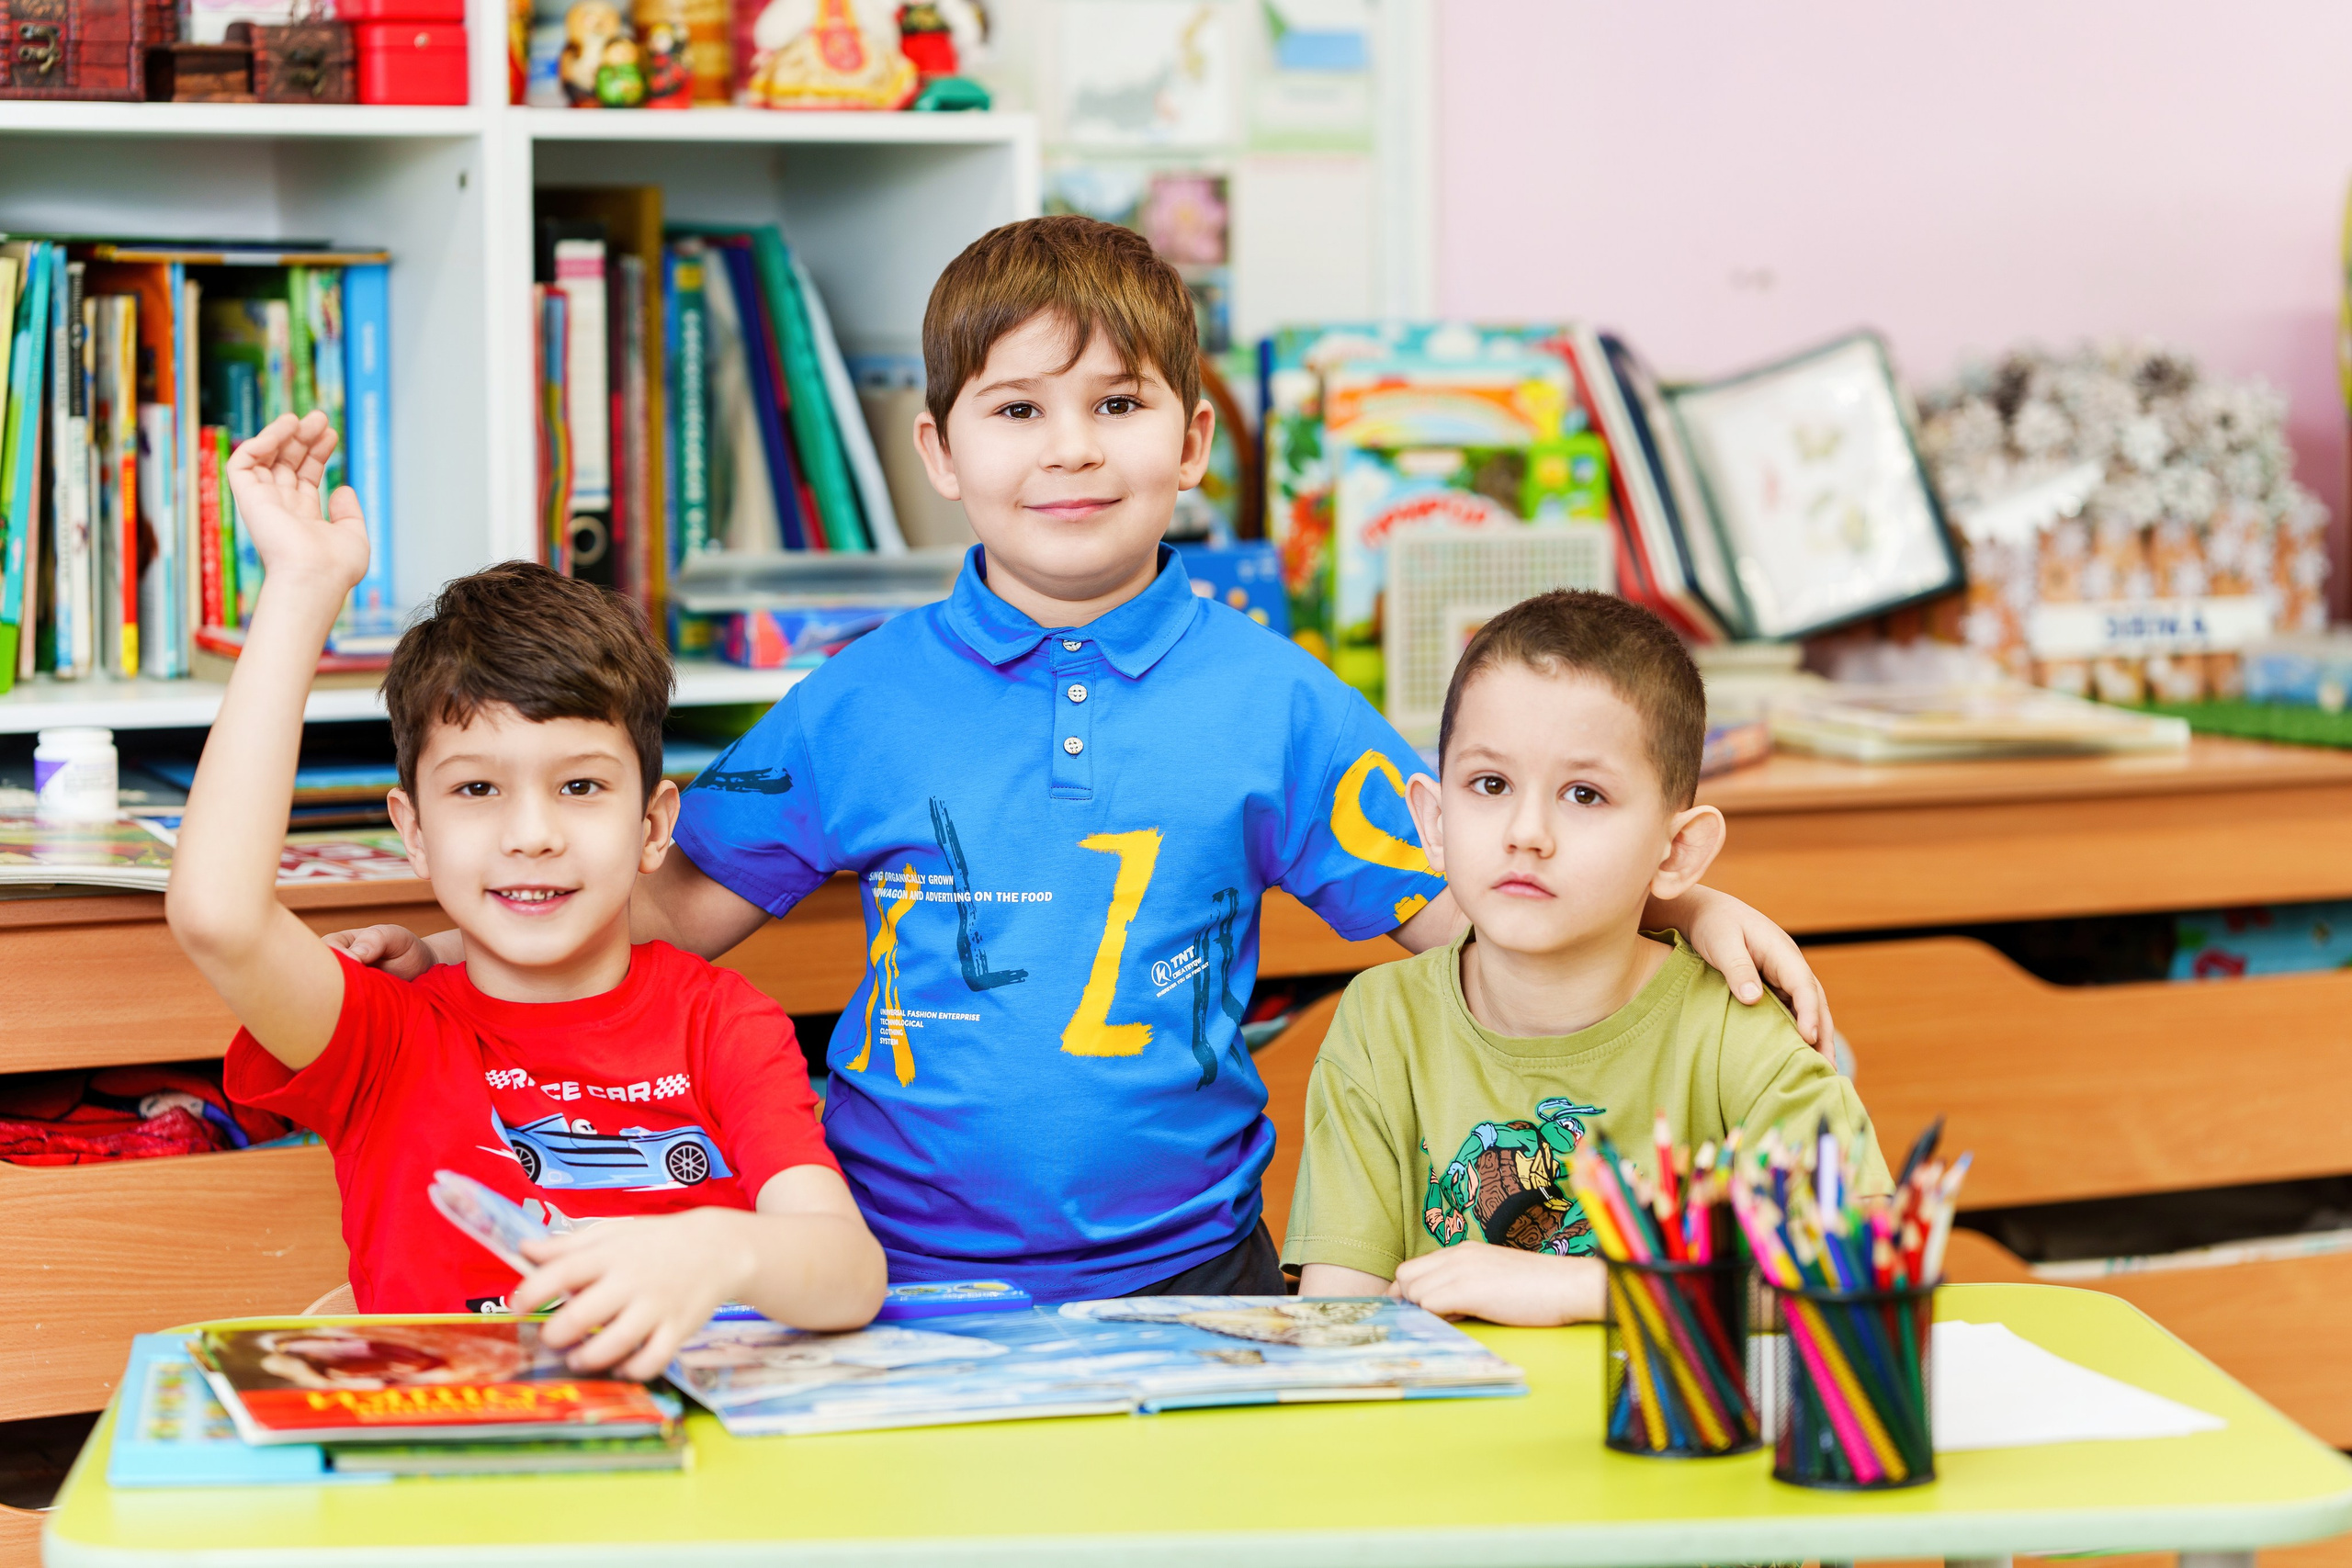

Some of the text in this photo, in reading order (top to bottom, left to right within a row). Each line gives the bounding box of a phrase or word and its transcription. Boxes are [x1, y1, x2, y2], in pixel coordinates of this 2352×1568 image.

[885, 872, 926, 885] ORGANICALLY
[928, 874, 954, 886] GROWN
[909, 890, 924, 901] AND
[974, 891, 992, 902] ON
[996, 892, 1019, 903] THE
[1021, 891, 1053, 903] FOOD
[1170, 944, 1195, 968] TNT
[879, 1009, 981, 1021] UNIVERSAL FASHION ENTERPRISE
[880, 1018, 924, 1028] TECHNOLOGICAL
[879, 1028, 904, 1036] CLOTHING
[879, 1037, 899, 1045] SYSTEM
[586, 1081, 650, 1102] CAR
